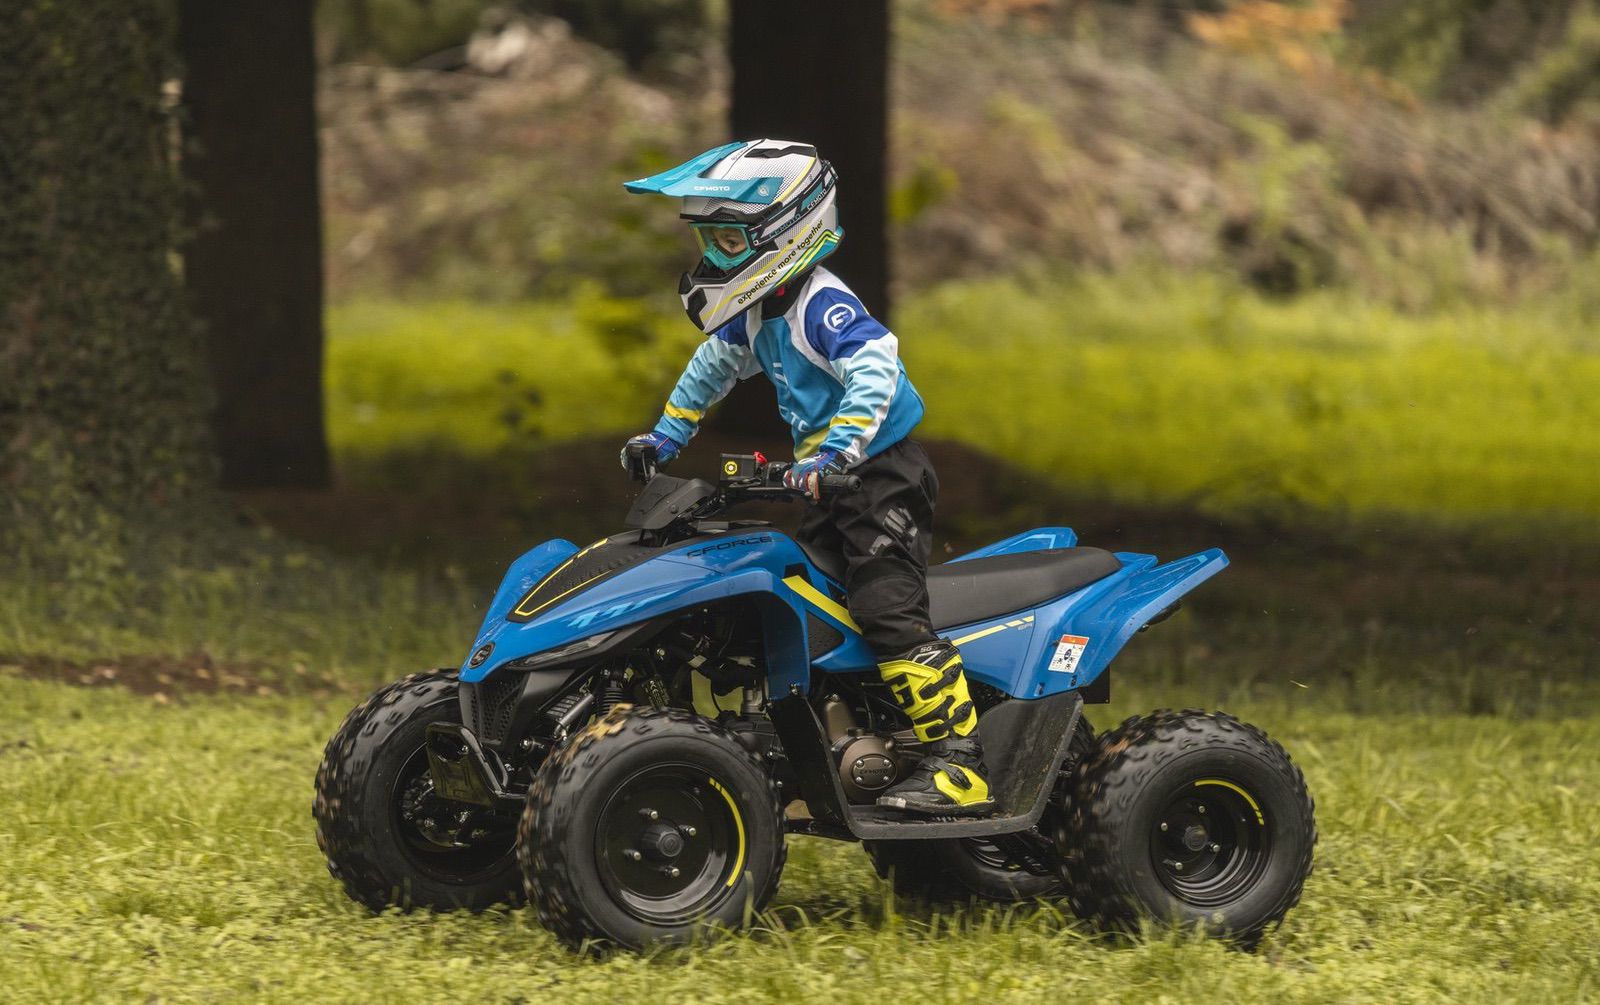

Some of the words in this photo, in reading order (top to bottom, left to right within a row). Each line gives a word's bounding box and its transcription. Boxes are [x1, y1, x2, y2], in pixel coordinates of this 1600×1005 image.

[737, 268, 777, 305] experience
[777, 249, 797, 269] more
[796, 219, 824, 251] together
[686, 535, 773, 558] CFORCE
